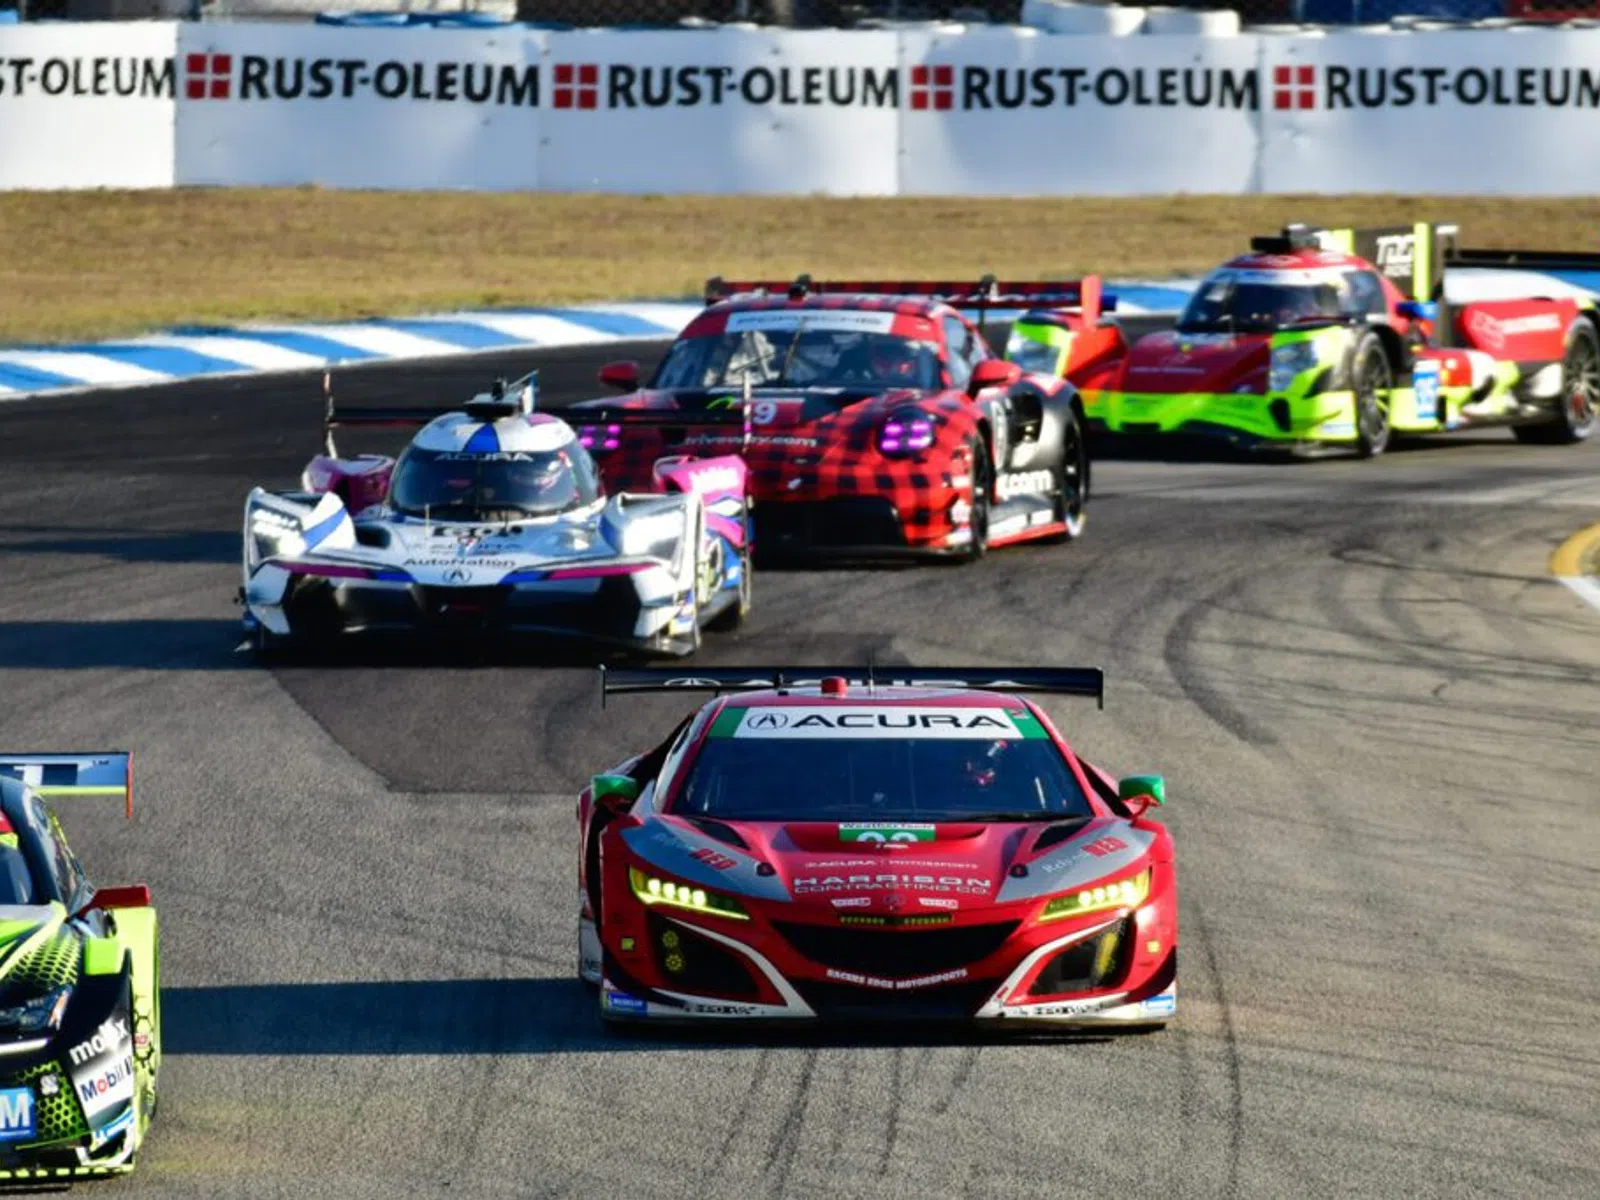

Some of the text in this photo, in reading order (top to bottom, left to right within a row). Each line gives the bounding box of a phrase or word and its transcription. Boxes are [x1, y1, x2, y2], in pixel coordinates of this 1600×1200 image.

[0, 57, 177, 99] T-OLEUM
[239, 55, 541, 107] RUST-OLEUM
[607, 63, 899, 109] RUST-OLEUM
[962, 65, 1261, 111] RUST-OLEUM
[752, 401, 777, 424] 9
[434, 451, 534, 463] ACURA
[402, 556, 517, 568] AutoNation
[790, 712, 1009, 730] ACURA
[793, 873, 992, 887] HARRISON
[794, 882, 951, 894] CONTRACTING
[826, 967, 968, 990] RACERS EDGE MOTORSPORTS
[79, 1066, 125, 1102] Mobil
